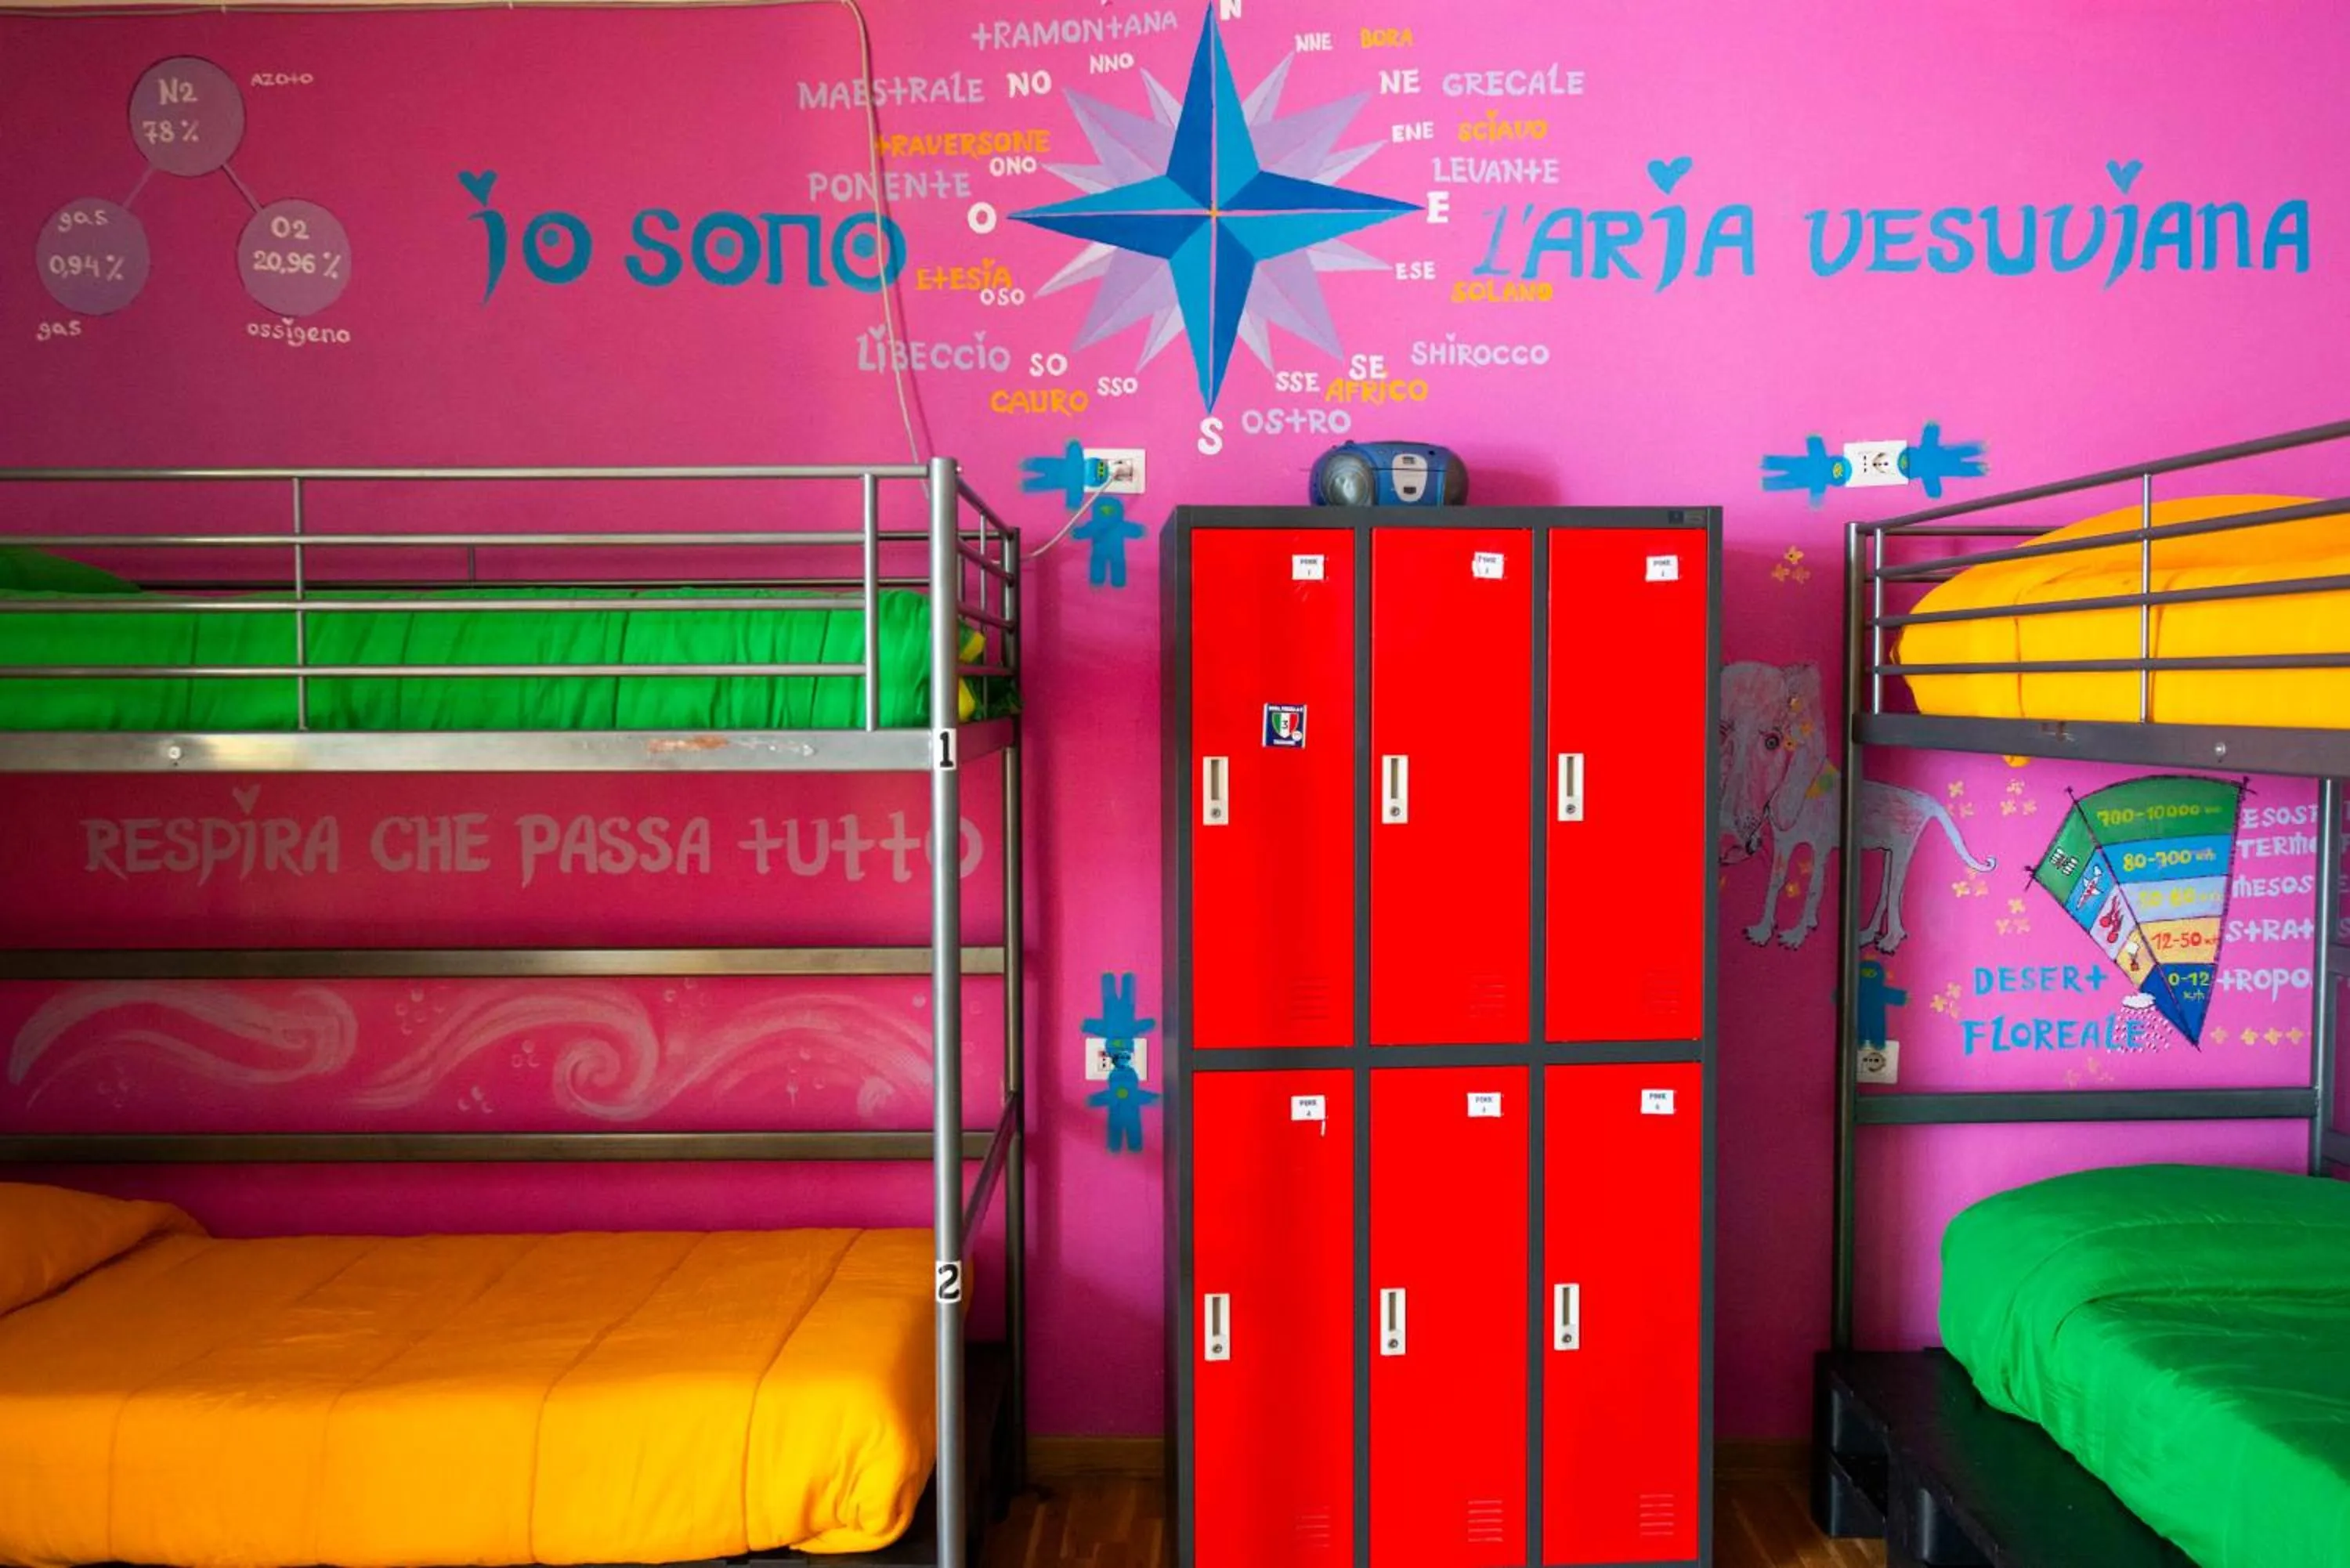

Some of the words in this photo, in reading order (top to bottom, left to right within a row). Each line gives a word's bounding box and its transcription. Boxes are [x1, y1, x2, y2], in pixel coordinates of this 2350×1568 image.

[1220, 0, 1242, 21] N
[1295, 32, 1332, 52] NNE
[1360, 27, 1415, 49] BORA
[1089, 52, 1134, 75] NNO
[159, 78, 198, 105] N2
[251, 72, 313, 87] AZOTO
[796, 70, 985, 111] MAESTRALE
[1007, 70, 1051, 99] NO
[1379, 69, 1420, 95] NE
[1442, 63, 1585, 98] GRECALE
[143, 121, 174, 144] 78
[1391, 122, 1434, 143] ENE
[989, 157, 1038, 177] ONO
[1432, 157, 1560, 185] LEVANTE
[808, 171, 972, 203] PONENTE
[57, 209, 108, 233] gas
[967, 202, 997, 235] O
[1426, 191, 1450, 224] E
[1395, 262, 1437, 280] ESE
[980, 288, 1026, 306] OSO
[1450, 281, 1554, 303] SOLANO
[37, 320, 81, 341] gas
[247, 318, 351, 347] ossigeno
[856, 324, 1011, 374] LIBECCIO
[1410, 333, 1550, 367] SHIROCCO
[1029, 352, 1068, 378] SO
[1348, 354, 1388, 381] SE
[1097, 376, 1139, 396] SSO
[1274, 371, 1321, 393] SSE
[1325, 377, 1429, 406] AFRICO
[989, 388, 1090, 417] CAURO
[1241, 407, 1352, 435] OSTRO
[1197, 417, 1224, 456] S
[938, 732, 954, 768] 1
[80, 784, 340, 887] RESPIRA
[371, 812, 491, 873] CHE
[514, 814, 711, 890] PASSA
[1973, 963, 2108, 997] DESERT
[1961, 1013, 2146, 1057] FLOREALE
[938, 1263, 960, 1300] 2
